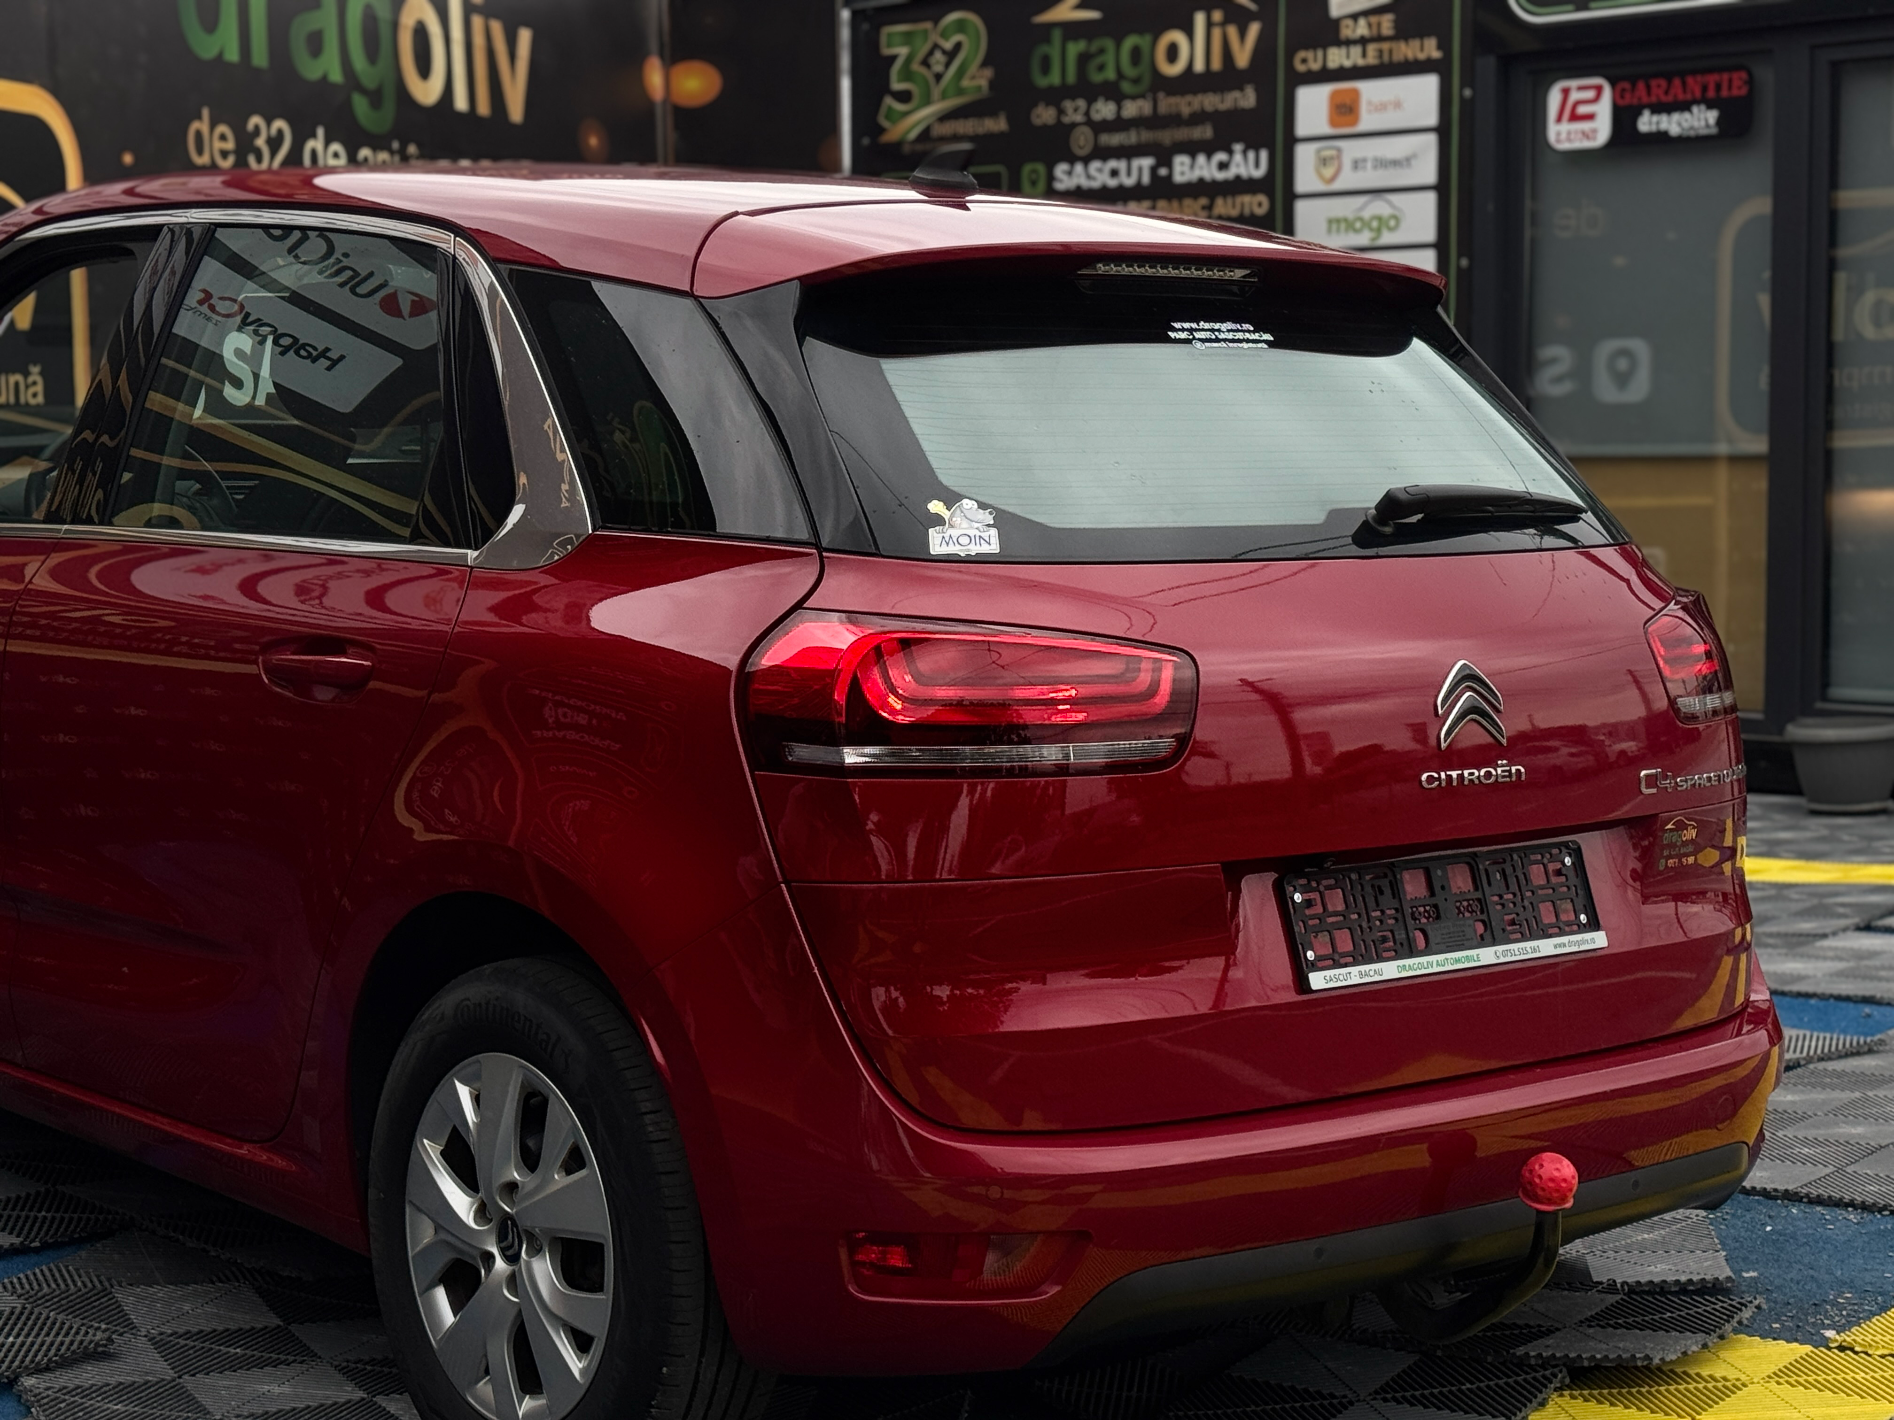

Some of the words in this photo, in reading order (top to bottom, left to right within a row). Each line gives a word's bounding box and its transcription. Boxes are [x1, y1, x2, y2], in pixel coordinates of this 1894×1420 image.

[1339, 14, 1396, 40] RATE
[1030, 9, 1263, 95] dragoliv
[1293, 49, 1324, 73] CU
[1325, 37, 1443, 70] BULETINUL
[876, 10, 989, 132] 32
[1613, 69, 1749, 106] GARANTIE
[1555, 84, 1604, 124] 12
[1636, 103, 1720, 137] dragoliv
[187, 106, 236, 169] de
[246, 114, 293, 170] 32
[1052, 155, 1156, 192] SASCUT
[1171, 141, 1270, 184] BACĂU
[1211, 192, 1271, 218] AUTO
[1326, 212, 1402, 243] mogo
[939, 533, 992, 548] MOIN
[1421, 759, 1527, 789] CITROËN
[1640, 768, 1675, 795] C4
[1323, 972, 1353, 984] SASCUT
[1358, 968, 1384, 980] BACAU
[1396, 962, 1434, 974] DRAGOLIV
[1435, 953, 1482, 968] AUTOMOBILE
